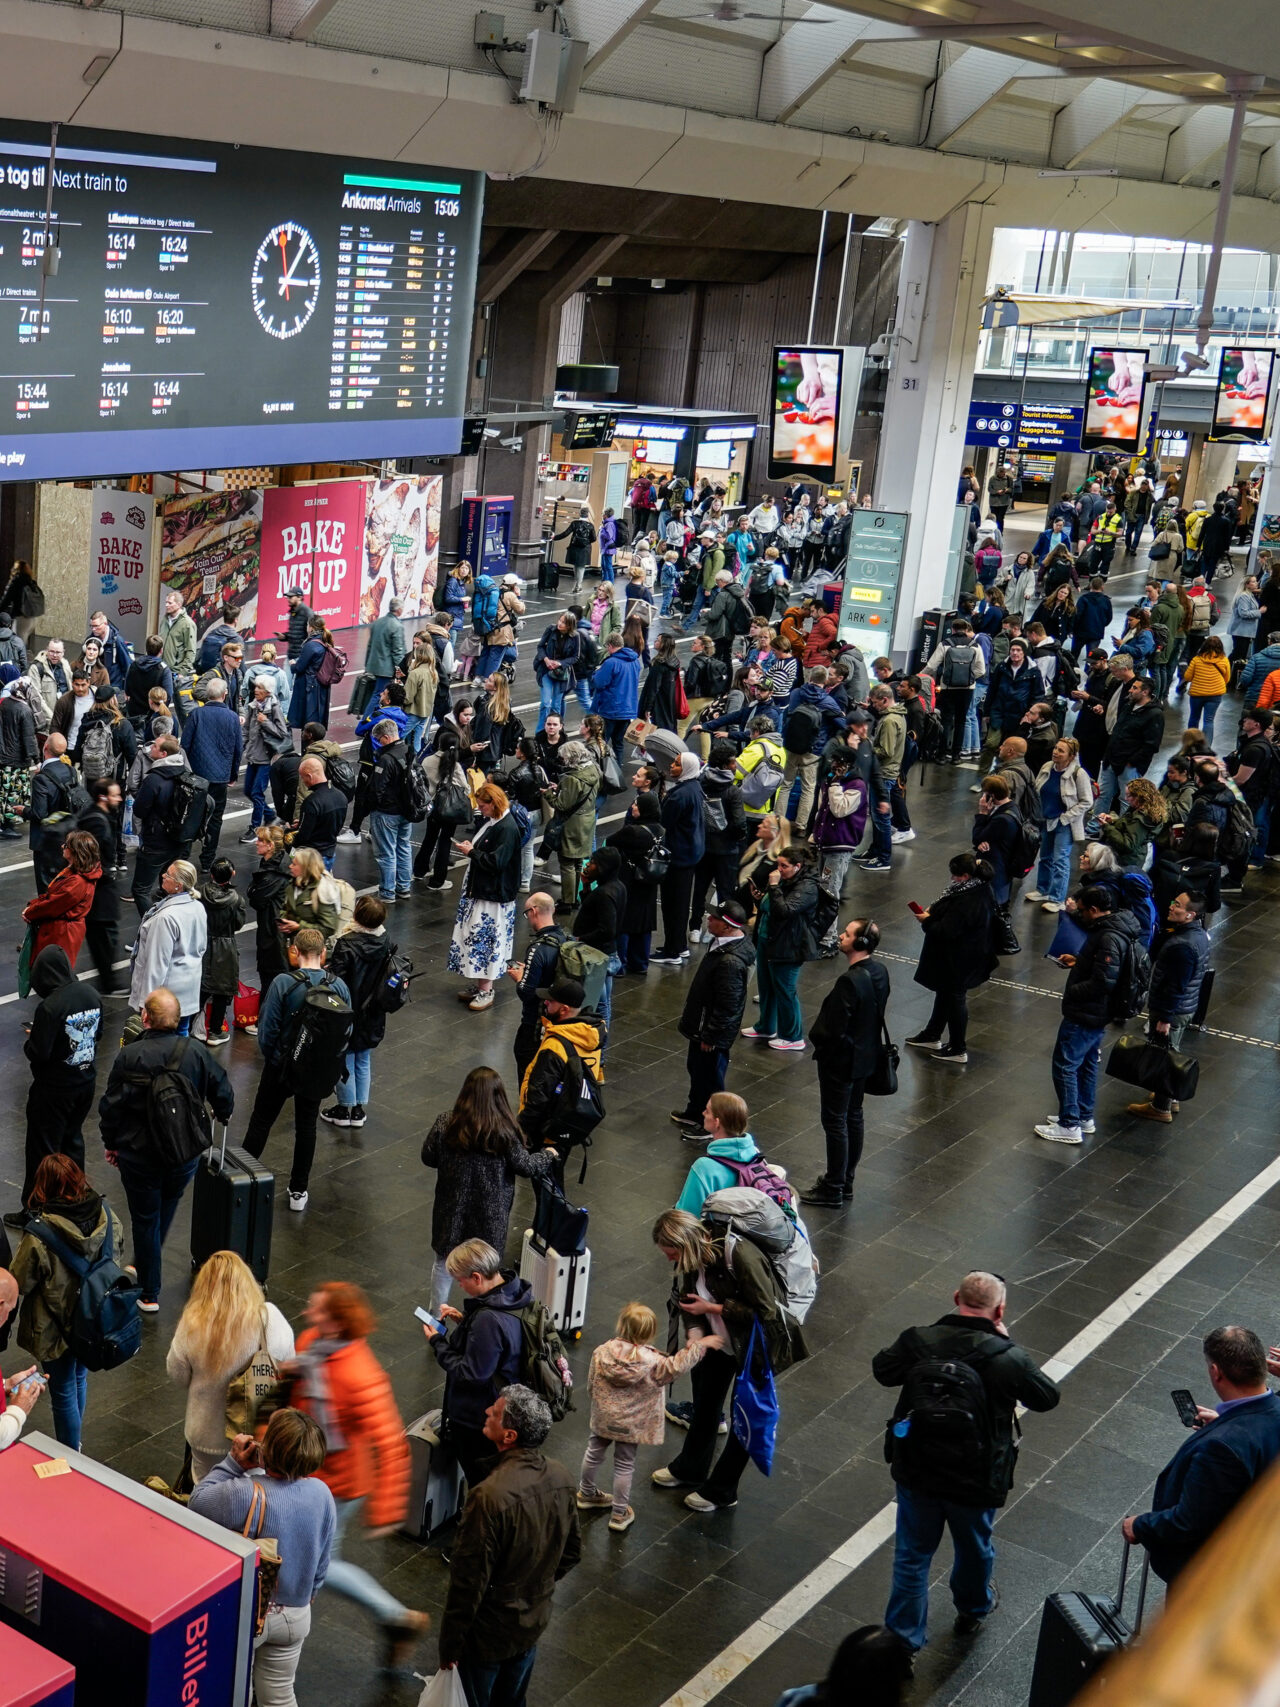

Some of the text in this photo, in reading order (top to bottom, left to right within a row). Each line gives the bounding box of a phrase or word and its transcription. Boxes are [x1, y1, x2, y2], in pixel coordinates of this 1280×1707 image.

[7, 165, 29, 189] tog
[32, 166, 44, 187] til
[52, 170, 81, 189] Next
[84, 172, 112, 192] train
[115, 174, 128, 192] to
[342, 191, 421, 214] Ankomst Arrivals
[434, 199, 460, 216] 15:06
[108, 233, 136, 250] 16:14
[160, 236, 188, 253] 16:24
[104, 309, 132, 324] 16:10
[157, 310, 184, 325] 16:20
[18, 384, 47, 399] 15:44
[101, 382, 128, 397] 16:14
[154, 381, 180, 396] 16:44
[904, 378, 916, 390] 31
[1042, 412, 1074, 420] information
[605, 430, 614, 441] 12
[1020, 426, 1064, 436] Luggage lockers
[6, 452, 26, 466] play
[282, 520, 346, 562] BAKE
[466, 532, 474, 556] Tickets
[100, 538, 142, 560] BAKE
[98, 556, 144, 580] ME UP
[194, 555, 225, 570] Join Our
[200, 564, 220, 576] Team
[276, 558, 348, 599] ME UP
[848, 612, 866, 624] ARK
[920, 633, 932, 663] Billetter
